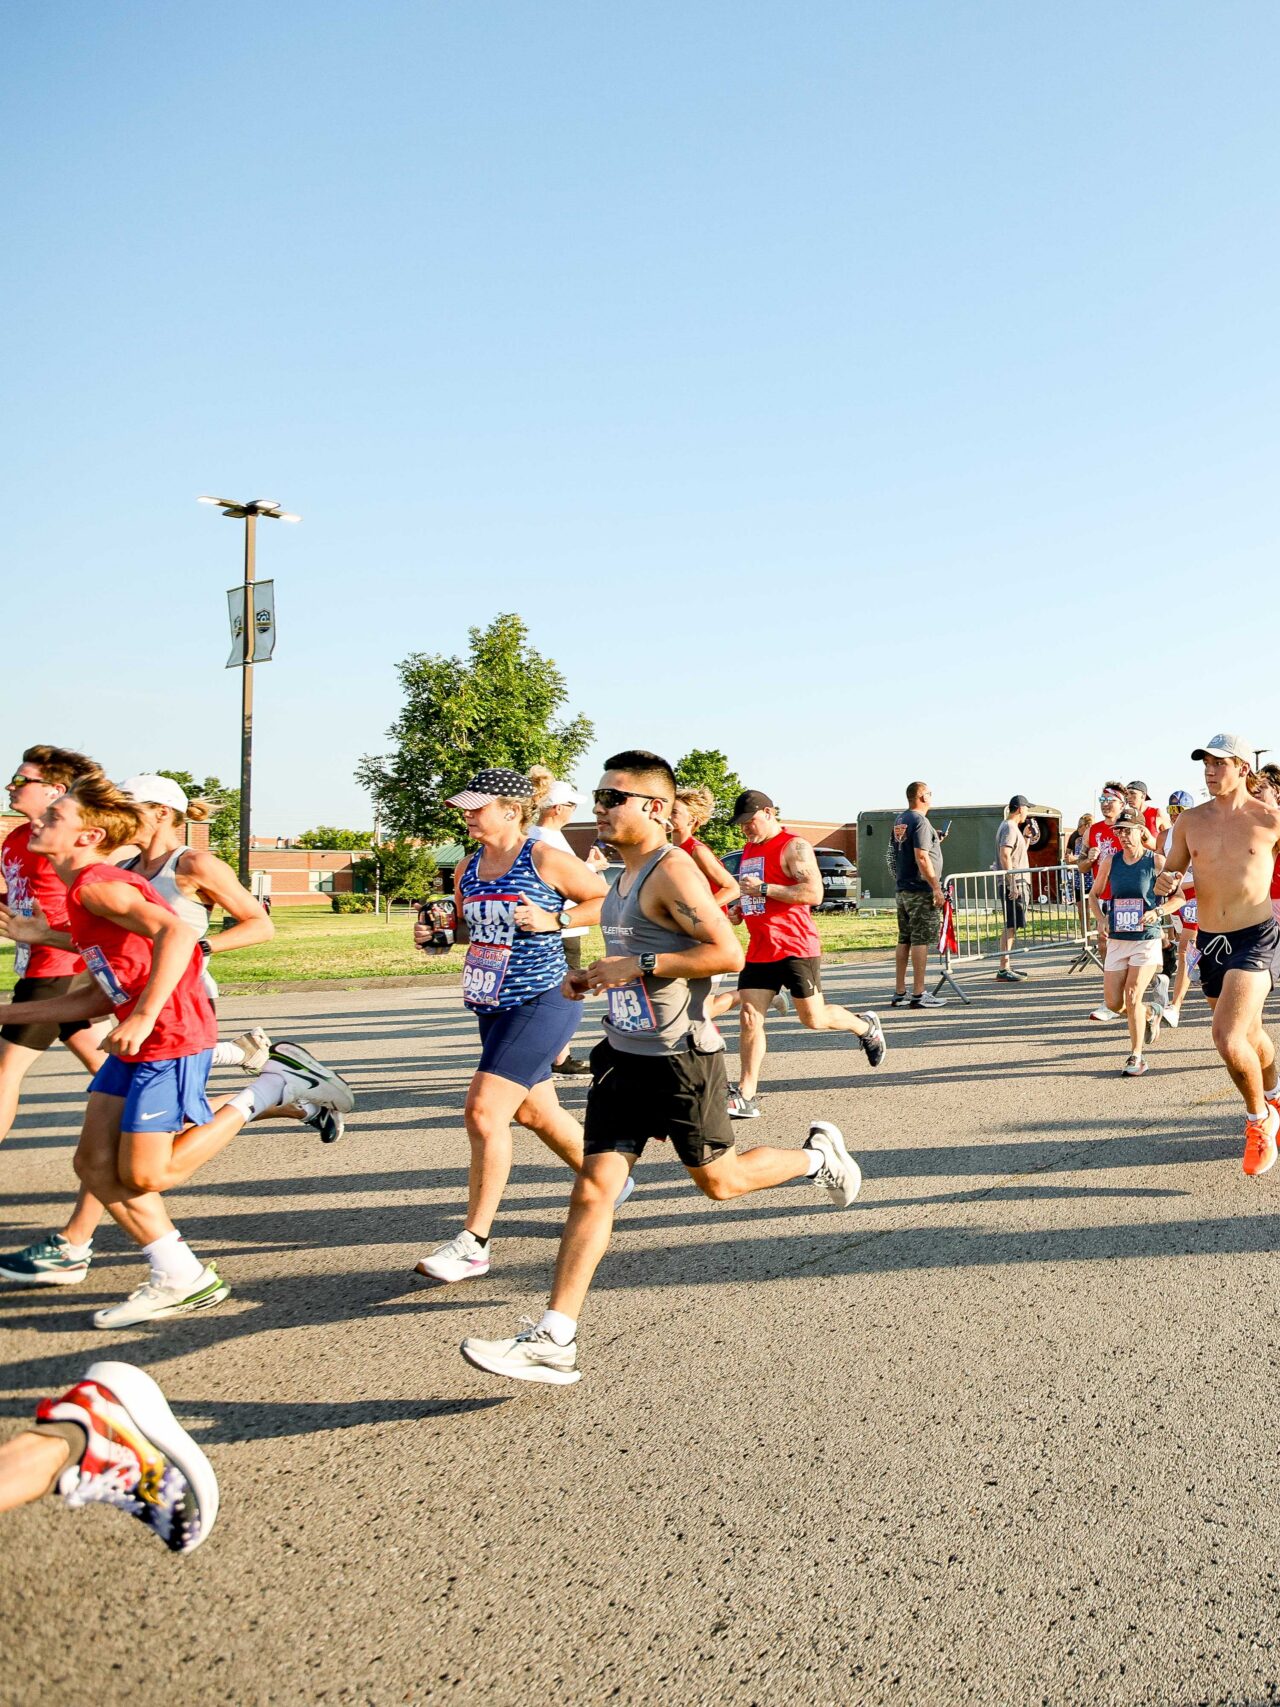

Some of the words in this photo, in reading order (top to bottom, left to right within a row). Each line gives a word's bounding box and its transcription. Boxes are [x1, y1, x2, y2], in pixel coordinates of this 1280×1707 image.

[462, 900, 518, 927] RUN
[1116, 911, 1139, 925] 908
[462, 965, 496, 994] 698
[611, 989, 642, 1018] 433
